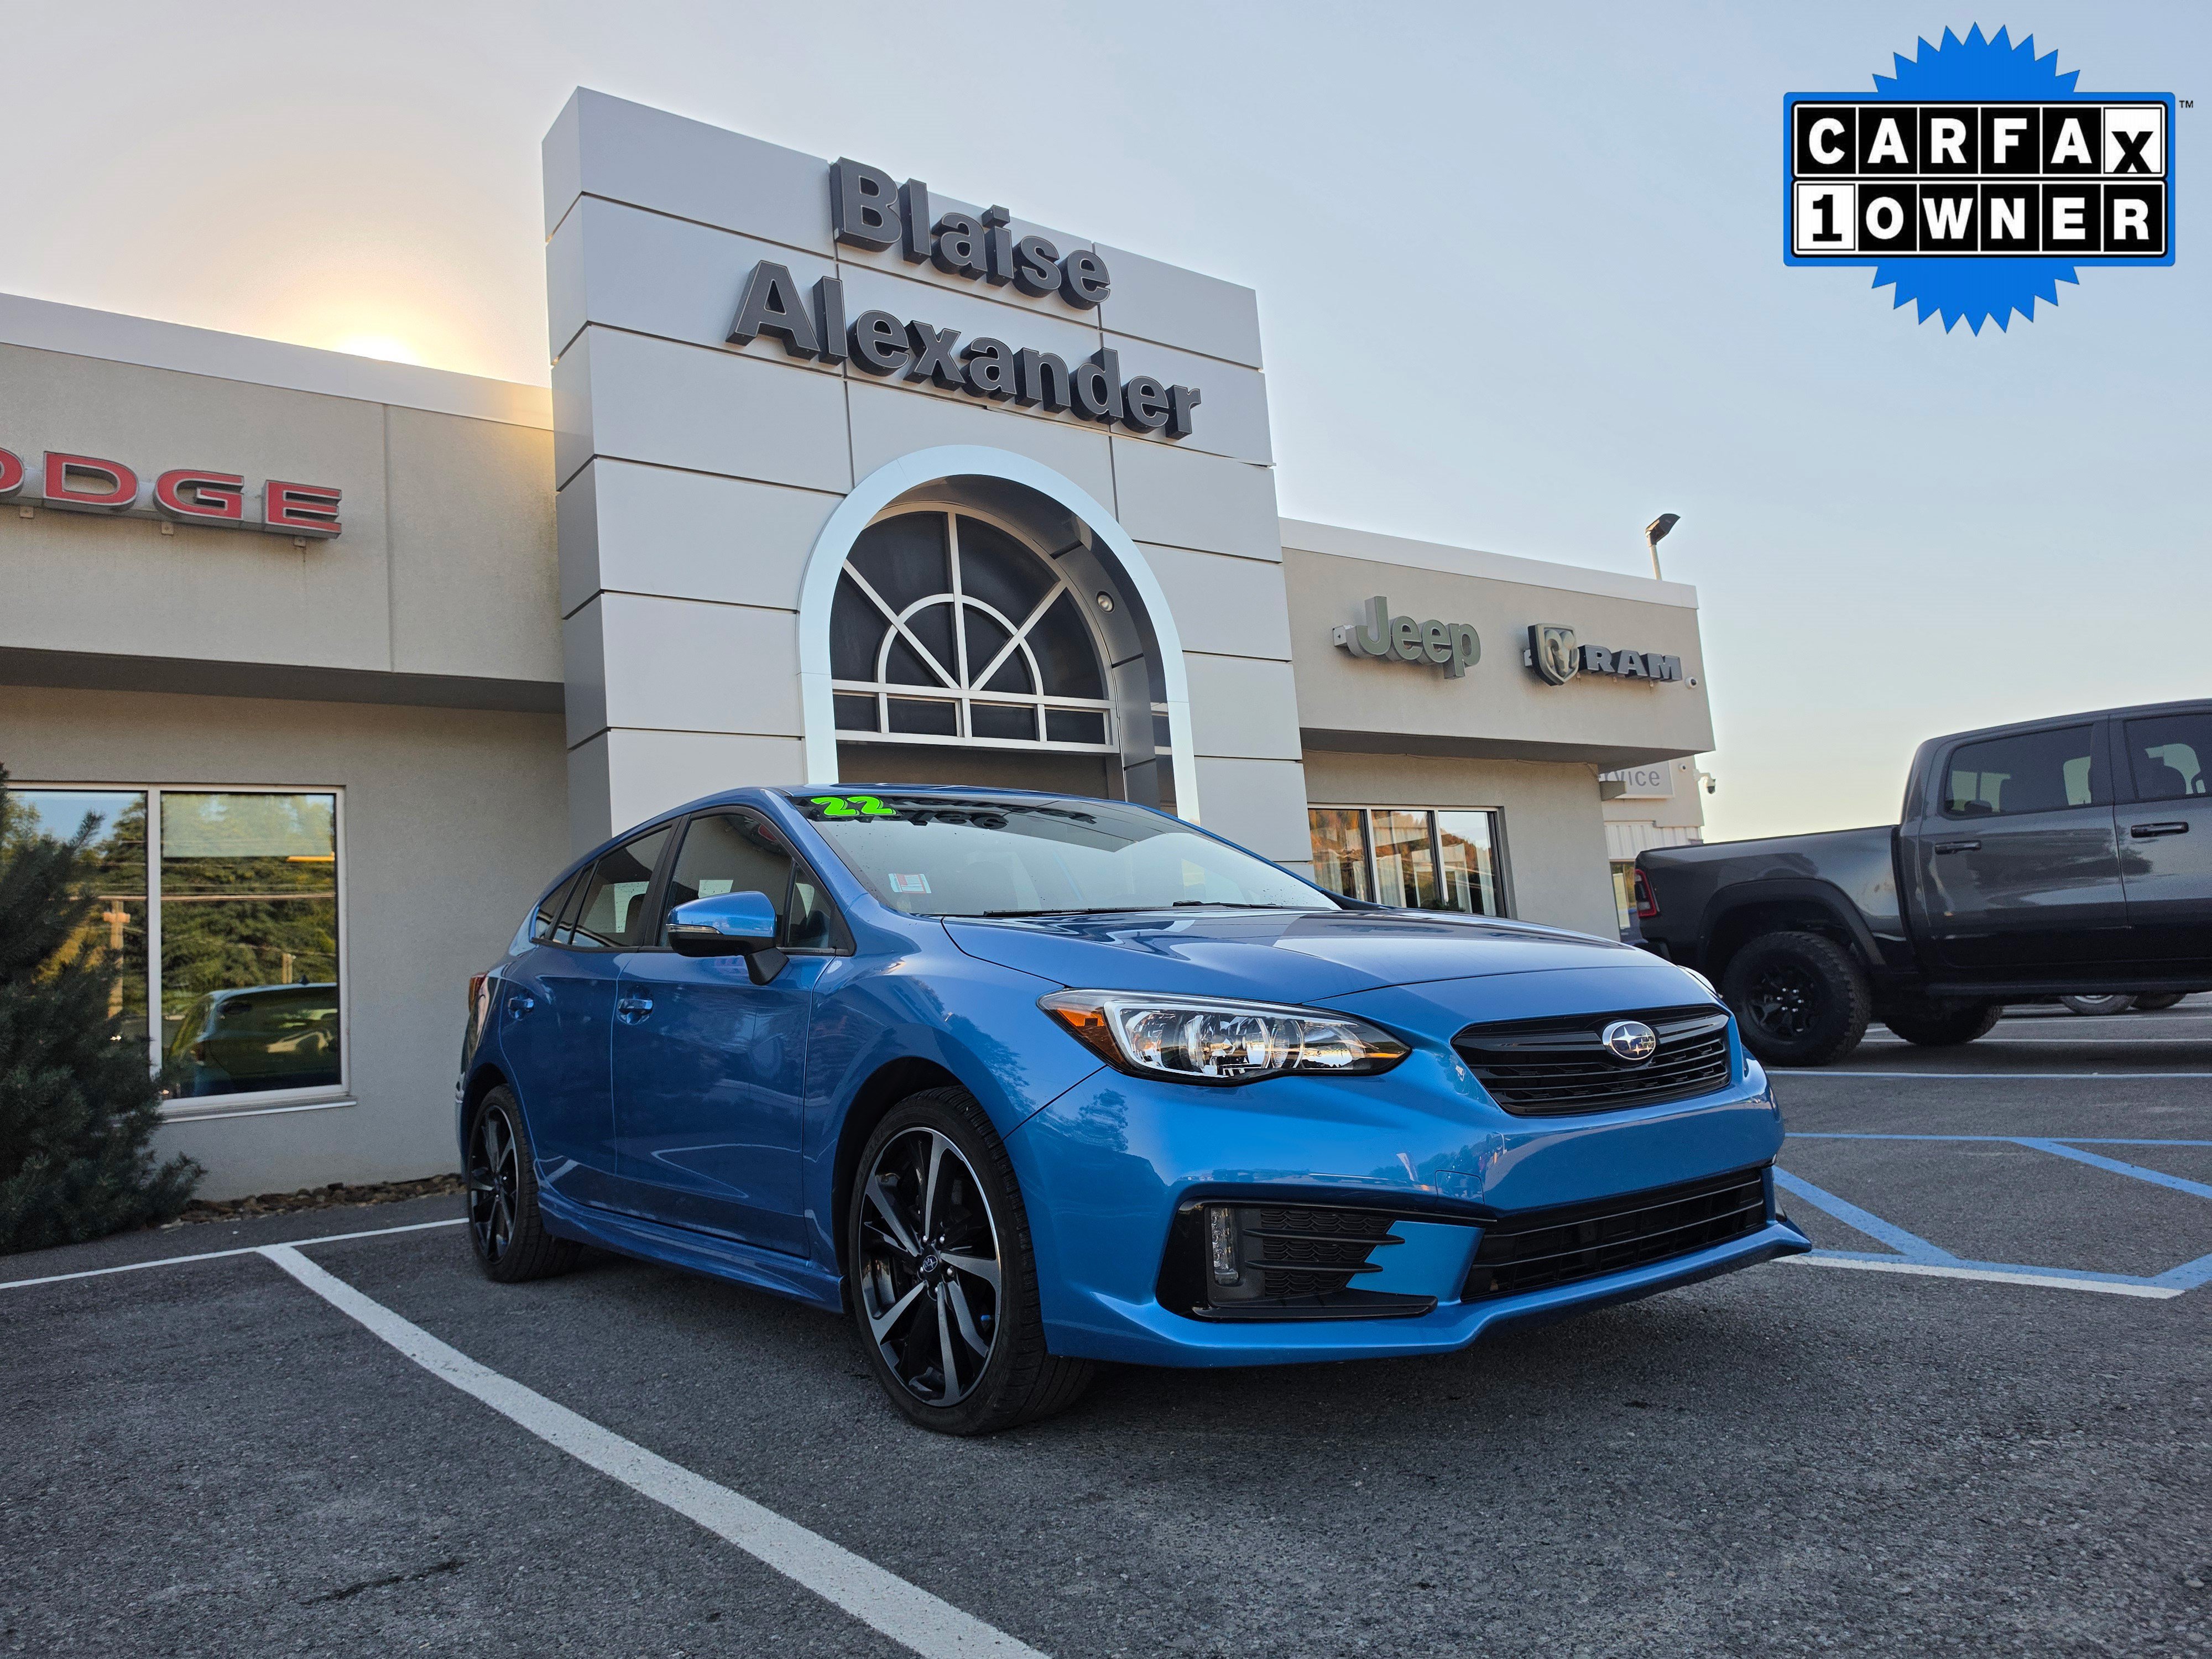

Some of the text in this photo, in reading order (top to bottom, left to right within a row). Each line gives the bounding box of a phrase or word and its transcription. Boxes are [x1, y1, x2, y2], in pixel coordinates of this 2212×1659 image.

[830, 156, 1111, 310] Blaise
[726, 259, 1202, 440] Alexander
[0, 447, 342, 539] DGE
[1347, 596, 1481, 680] Jeep
[1578, 644, 1682, 682] RAM
[811, 796, 896, 816] 22
[1599, 771, 1660, 787] rvice
